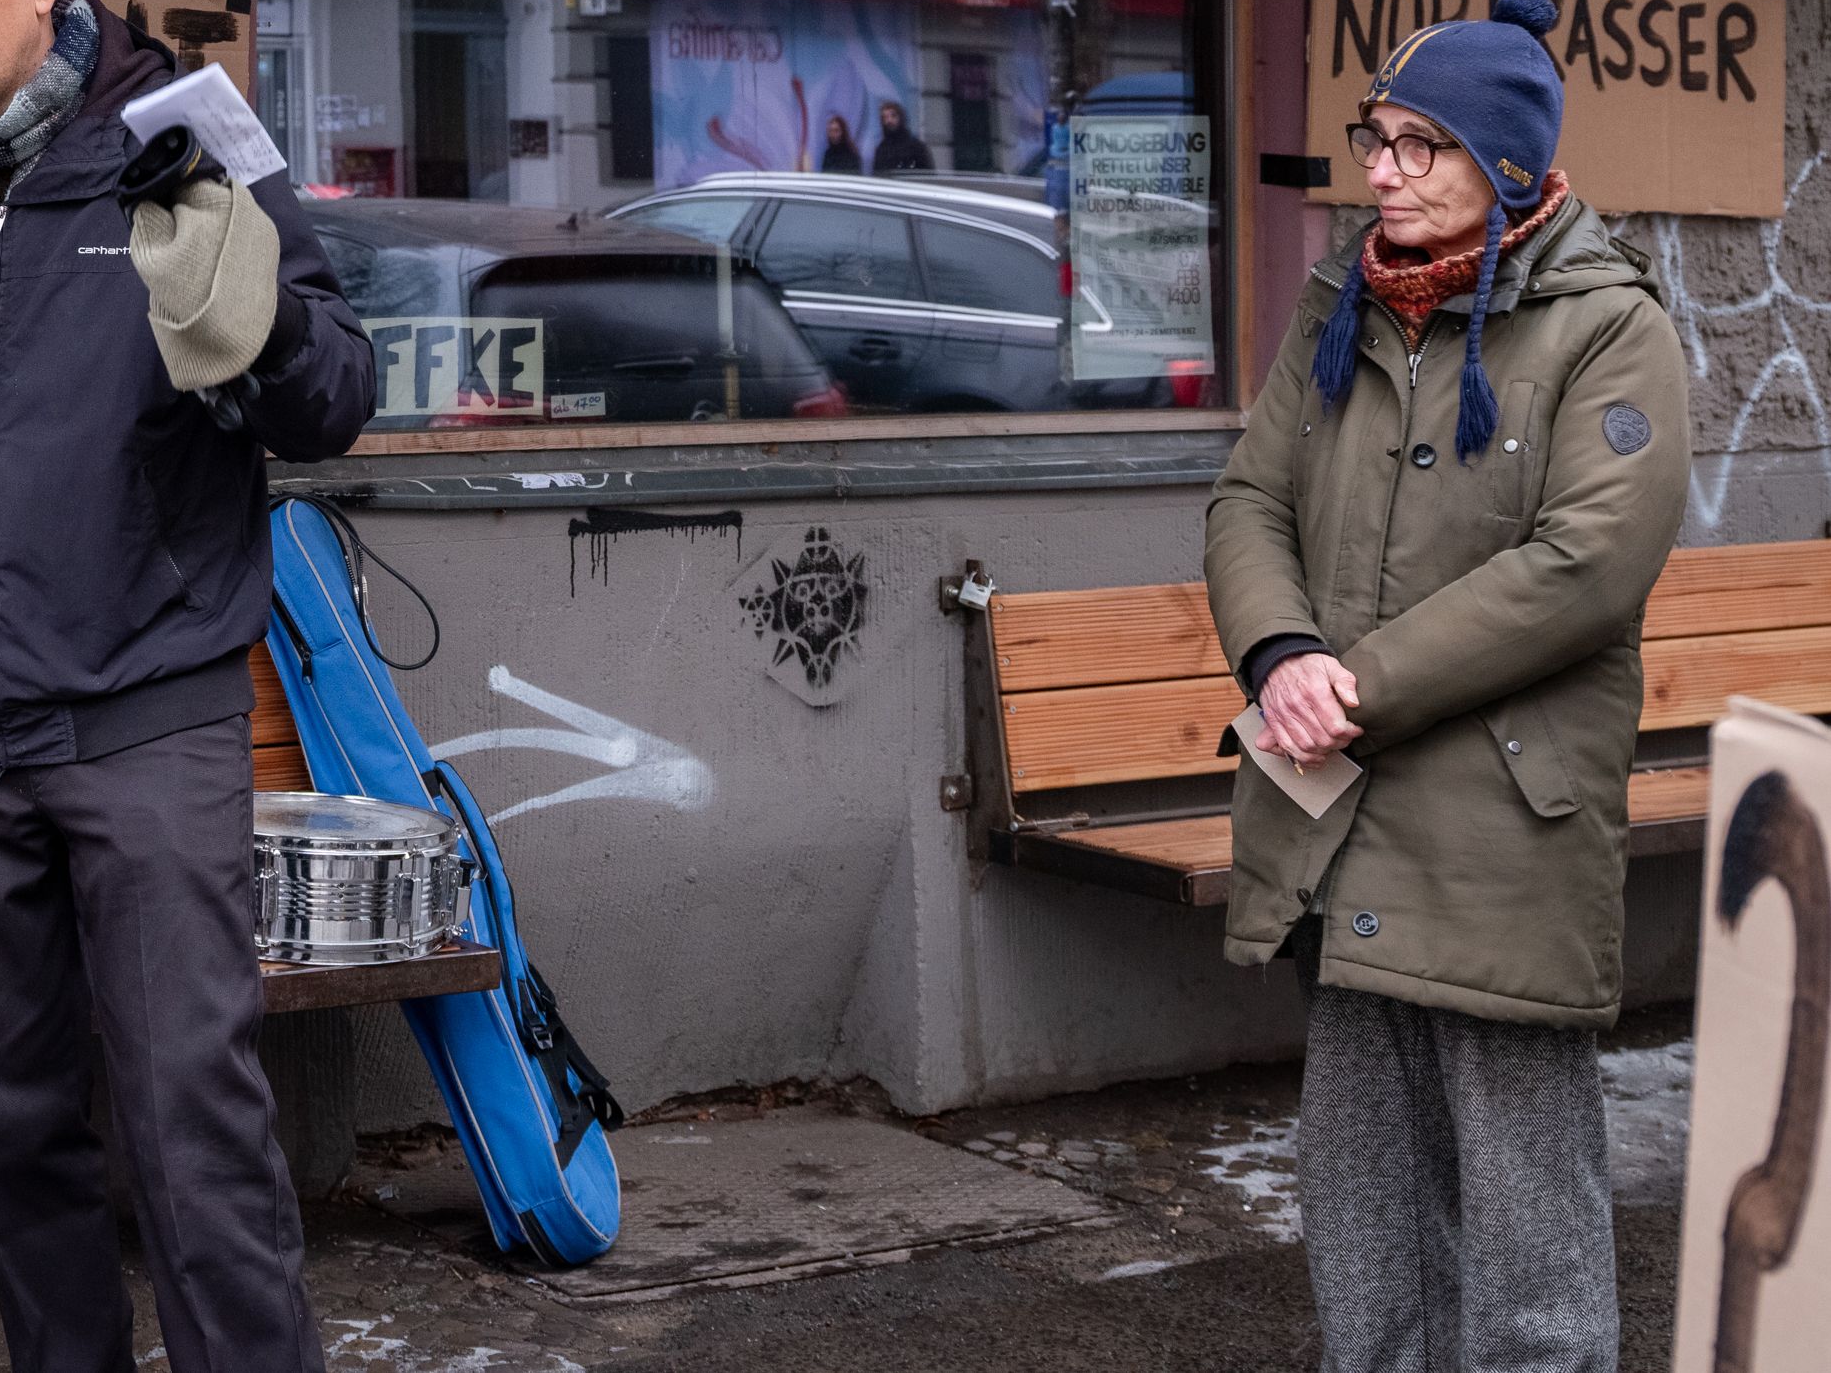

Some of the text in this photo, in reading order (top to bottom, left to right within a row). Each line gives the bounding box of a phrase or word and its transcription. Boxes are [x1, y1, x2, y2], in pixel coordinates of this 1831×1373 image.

[1074, 131, 1206, 155] KUNDGEBUNG
[1092, 157, 1191, 174] RETTET UNSER
